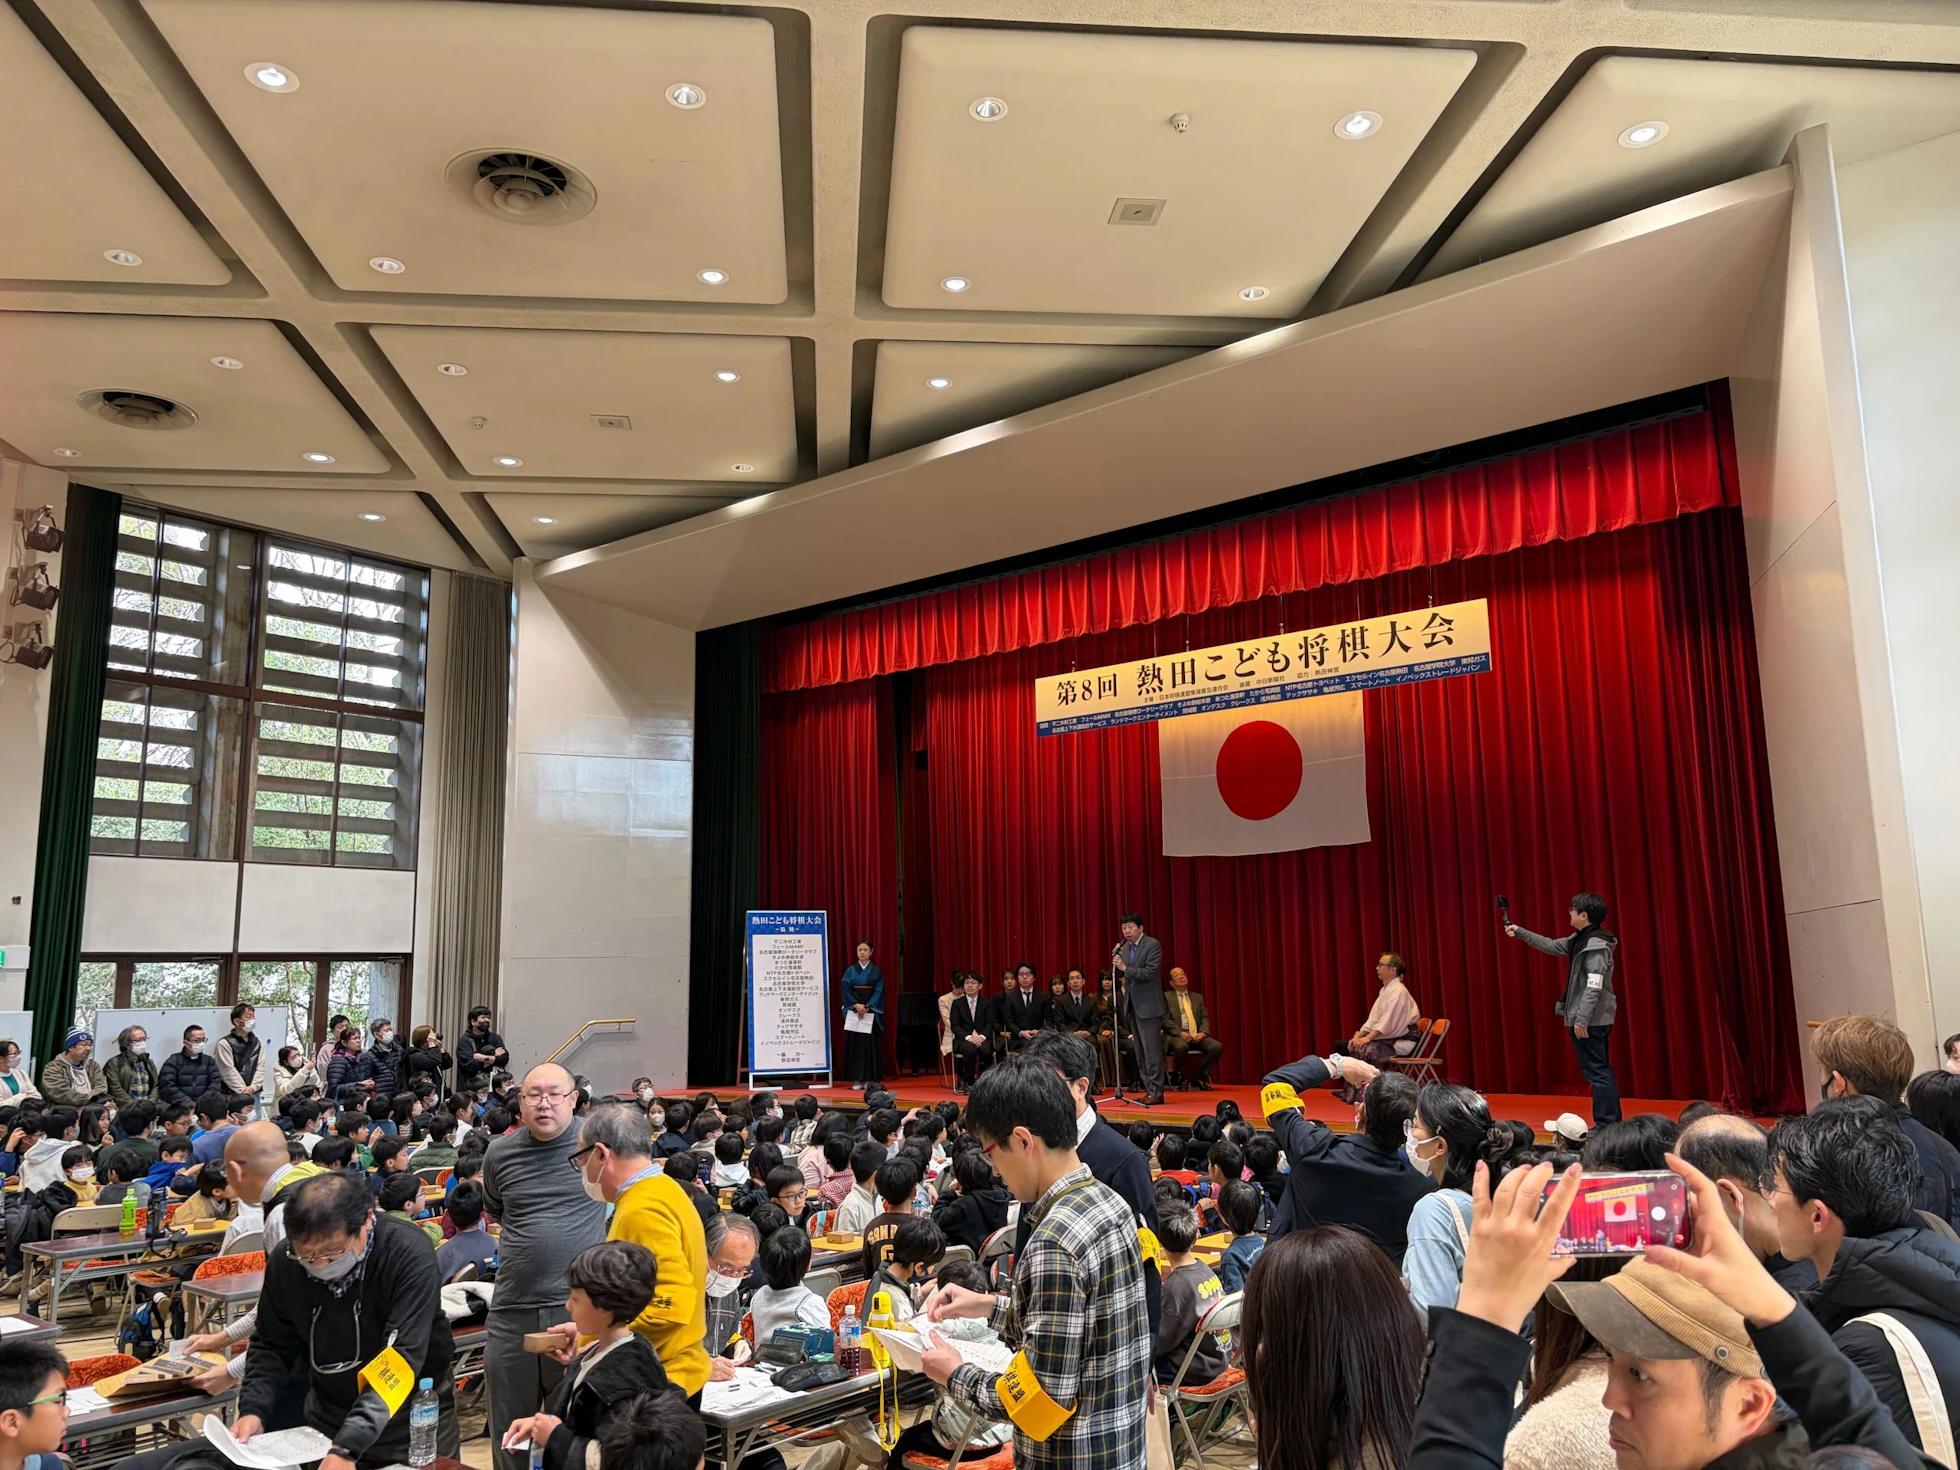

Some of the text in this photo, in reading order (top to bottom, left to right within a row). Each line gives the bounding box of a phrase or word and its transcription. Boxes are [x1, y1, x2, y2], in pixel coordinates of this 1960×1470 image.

[1057, 612, 1454, 707] 第8回 熱田こども将棋大会
[1351, 678, 1390, 689] スマートノート
